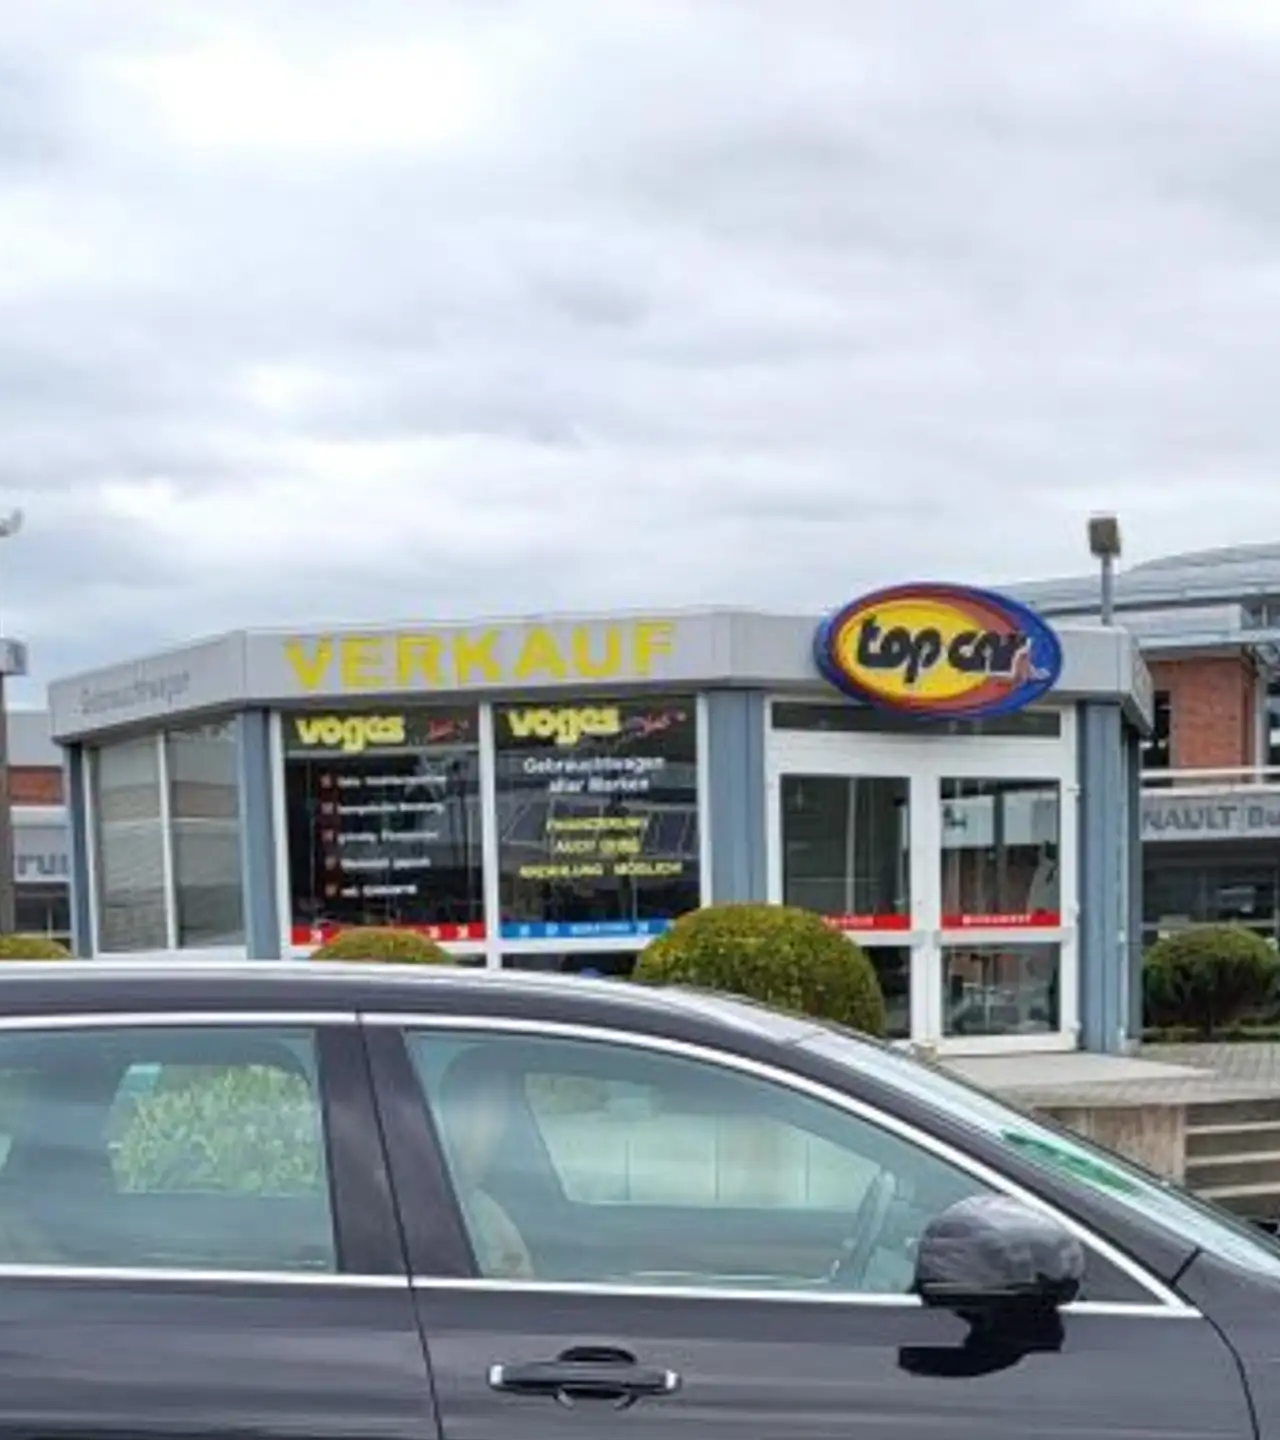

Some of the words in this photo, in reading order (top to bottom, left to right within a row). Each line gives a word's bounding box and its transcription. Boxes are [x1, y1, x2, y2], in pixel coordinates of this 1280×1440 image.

[283, 619, 675, 692] VERKAUF
[857, 613, 941, 683] top
[947, 630, 1028, 673] car
